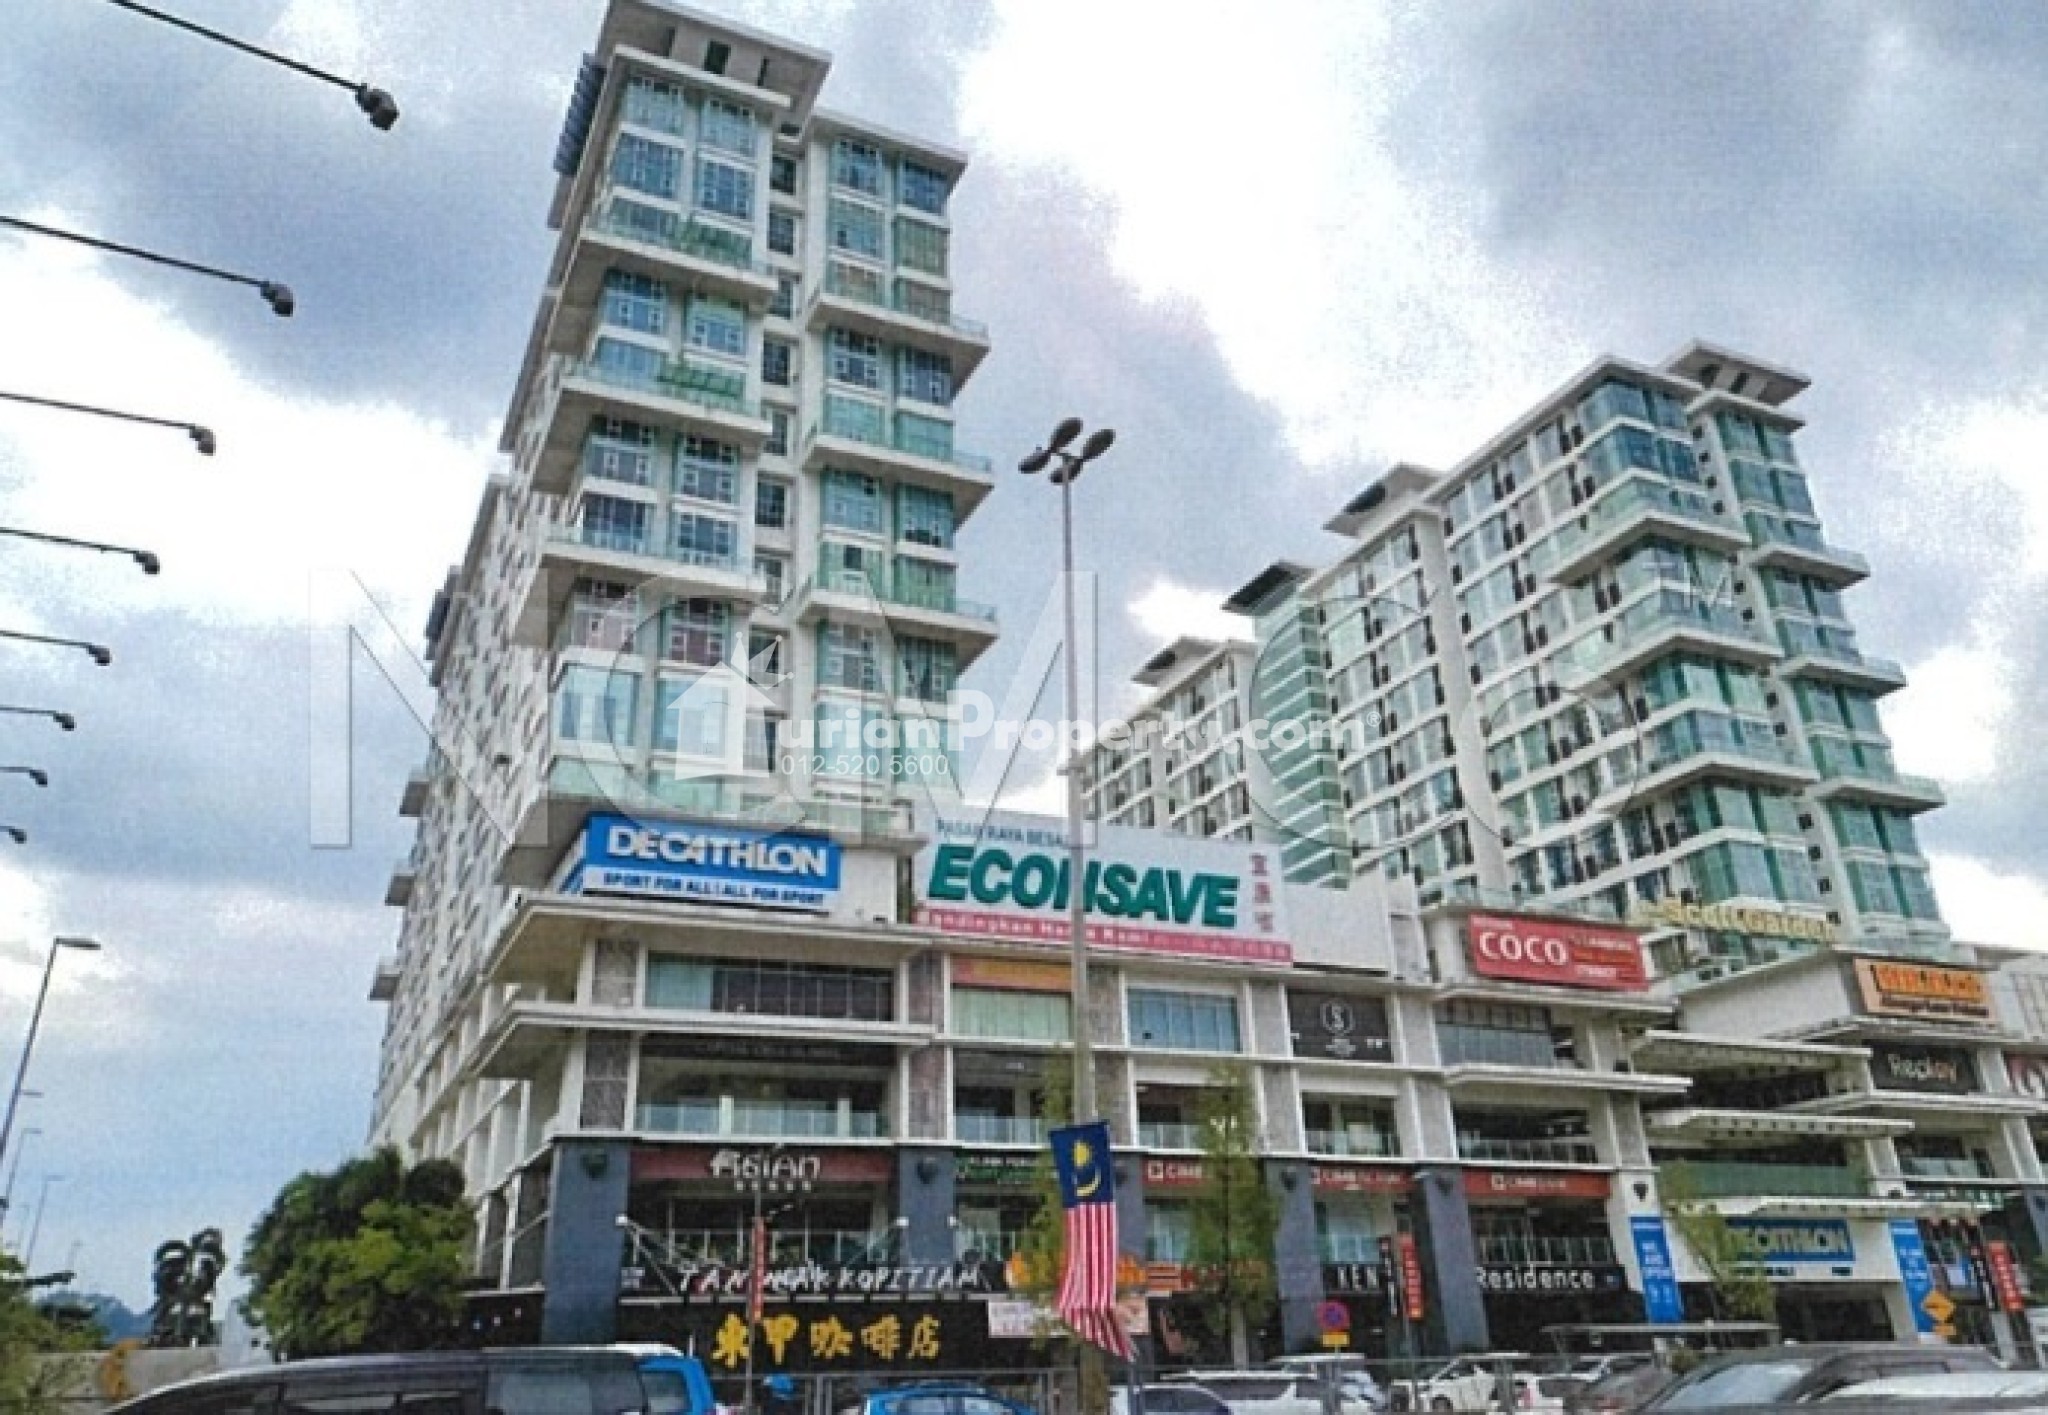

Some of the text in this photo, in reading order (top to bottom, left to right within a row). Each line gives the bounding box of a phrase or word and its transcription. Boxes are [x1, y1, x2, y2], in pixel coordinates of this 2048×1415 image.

[606, 825, 827, 877] DECATHLON
[603, 872, 652, 886] SPORT
[654, 875, 682, 889] FOR
[686, 880, 712, 893] ALL
[751, 887, 779, 899] FOR
[781, 889, 824, 904] SPORT
[928, 842, 1240, 928] ECONSAVE
[1479, 931, 1569, 966] COCO
[837, 1264, 980, 1292] KOPITIAM
[1475, 1264, 1596, 1290] Residence
